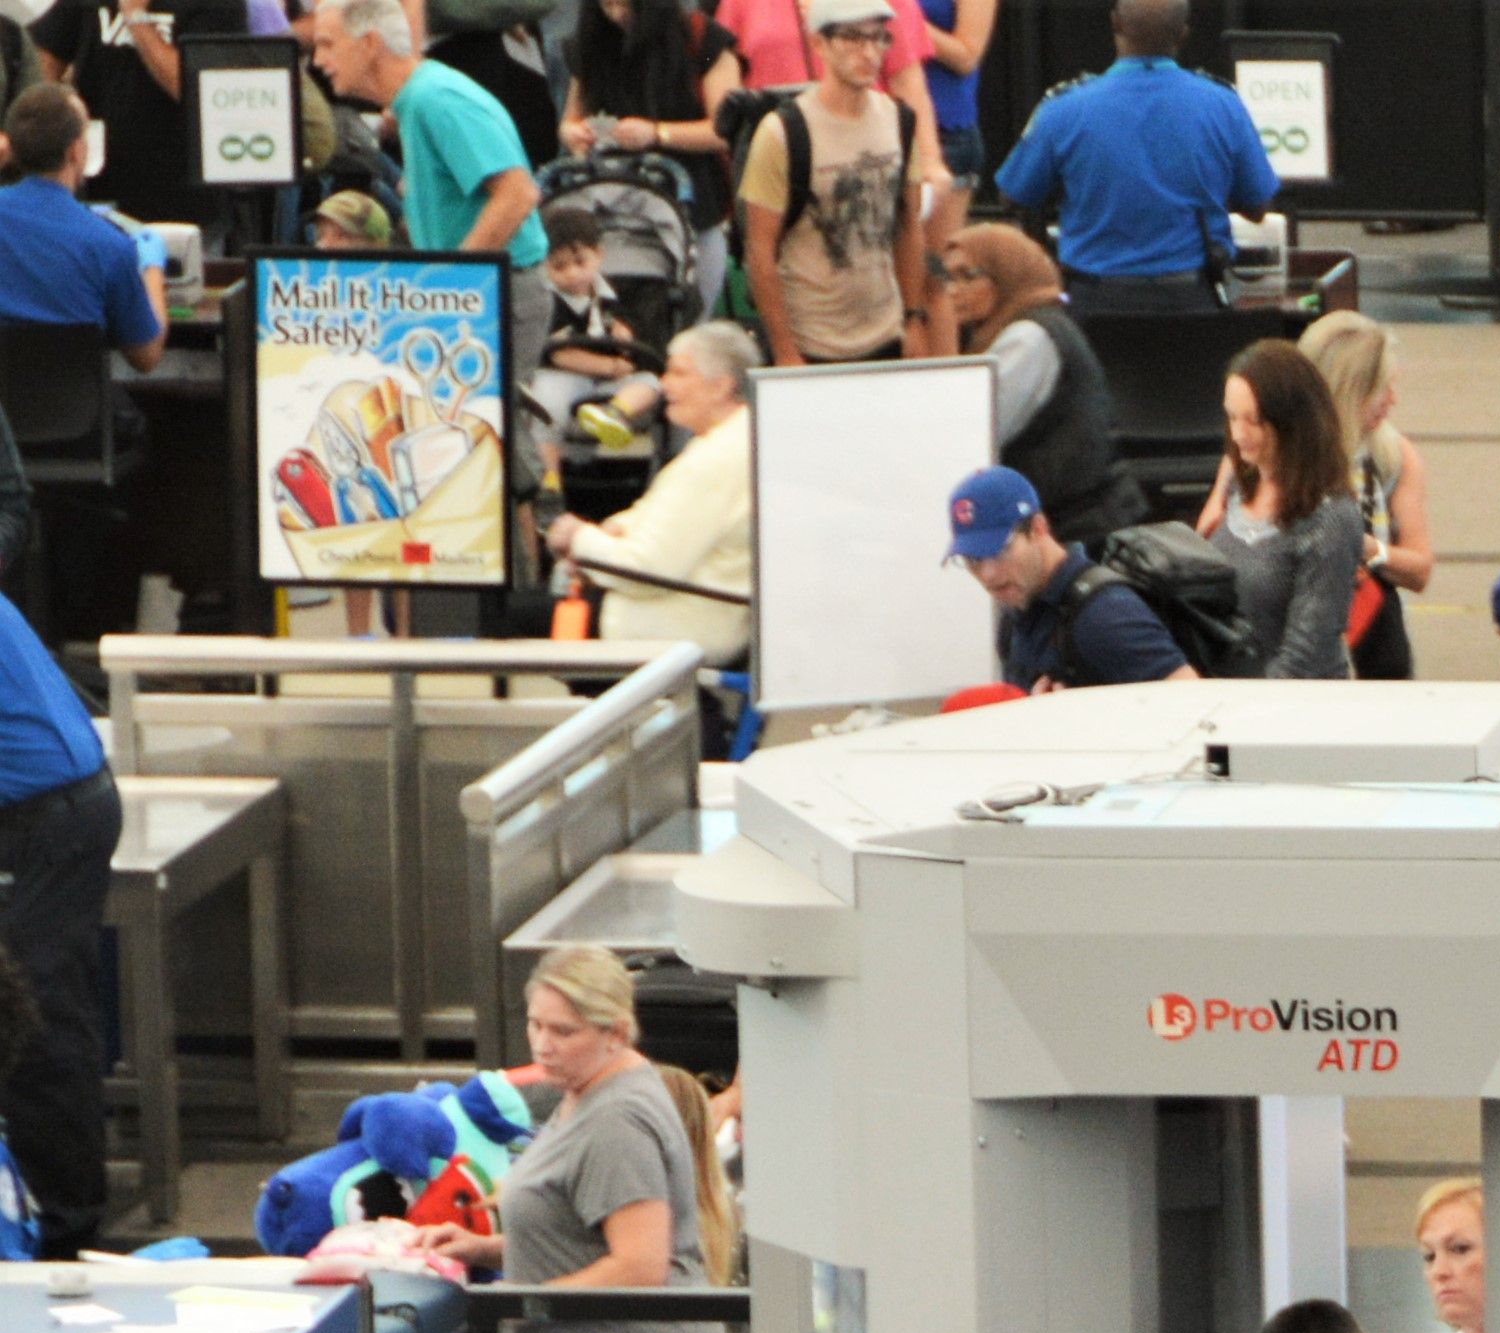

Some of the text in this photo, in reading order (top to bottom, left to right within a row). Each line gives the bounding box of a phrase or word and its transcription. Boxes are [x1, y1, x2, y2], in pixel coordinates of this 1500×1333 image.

[212, 88, 278, 109] OPEN
[1249, 80, 1311, 102] OPEN
[271, 278, 481, 313] Mail It Home
[273, 315, 379, 355] Safely!
[1203, 998, 1398, 1032] ProVision
[1316, 1039, 1400, 1073] ATD
